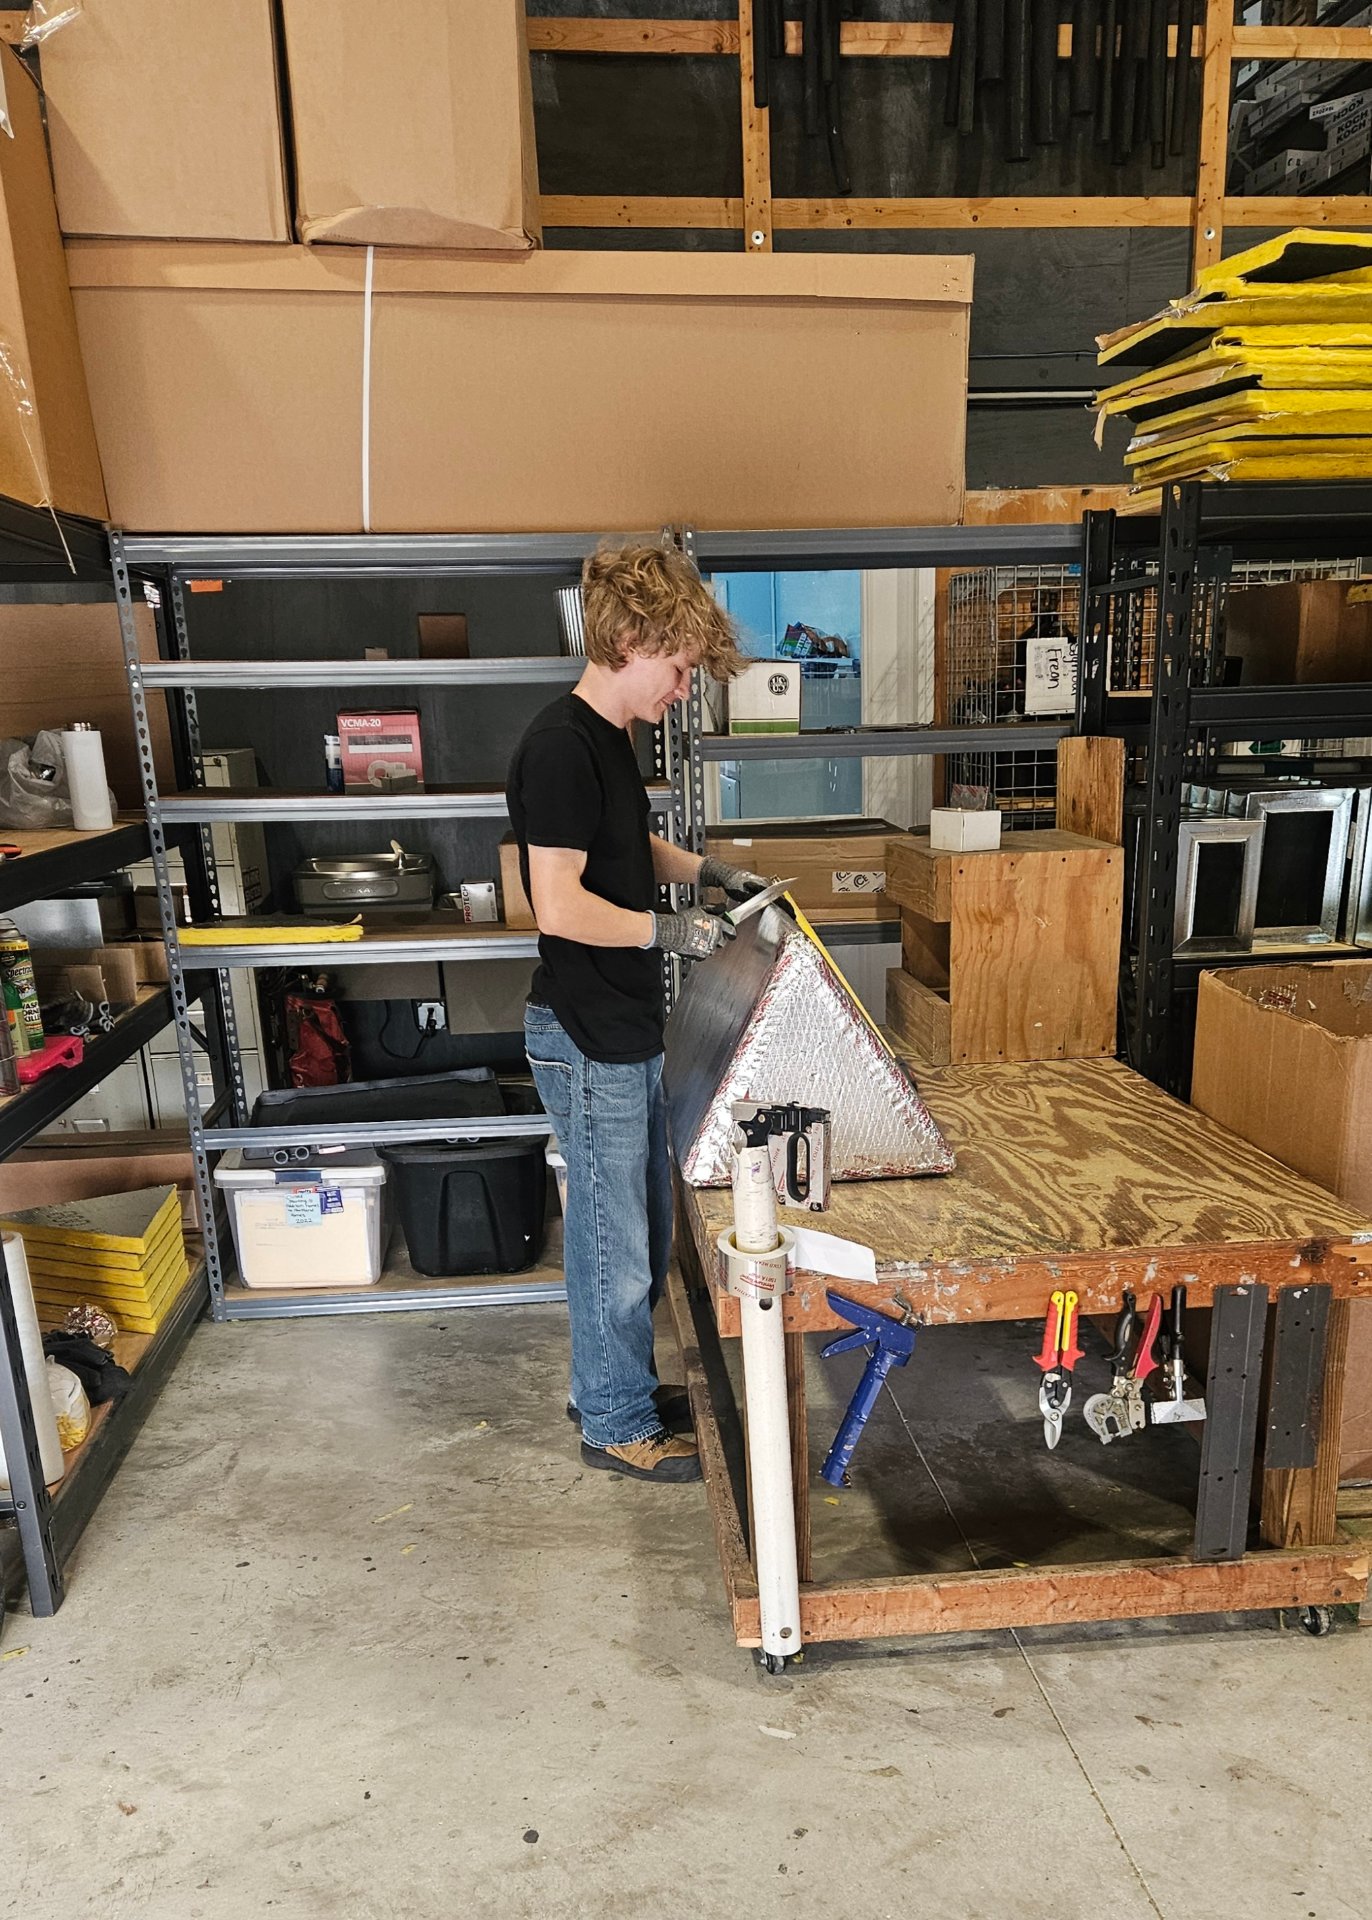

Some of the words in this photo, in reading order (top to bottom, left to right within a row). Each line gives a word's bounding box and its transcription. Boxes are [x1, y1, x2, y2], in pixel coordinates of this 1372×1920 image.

[1333, 96, 1364, 122] KOCH
[1337, 109, 1368, 134] KOCH
[1336, 119, 1366, 144] KOCH
[1047, 648, 1062, 689] Freon
[340, 718, 381, 728] VCMA-20
[462, 885, 472, 922] PROTECH
